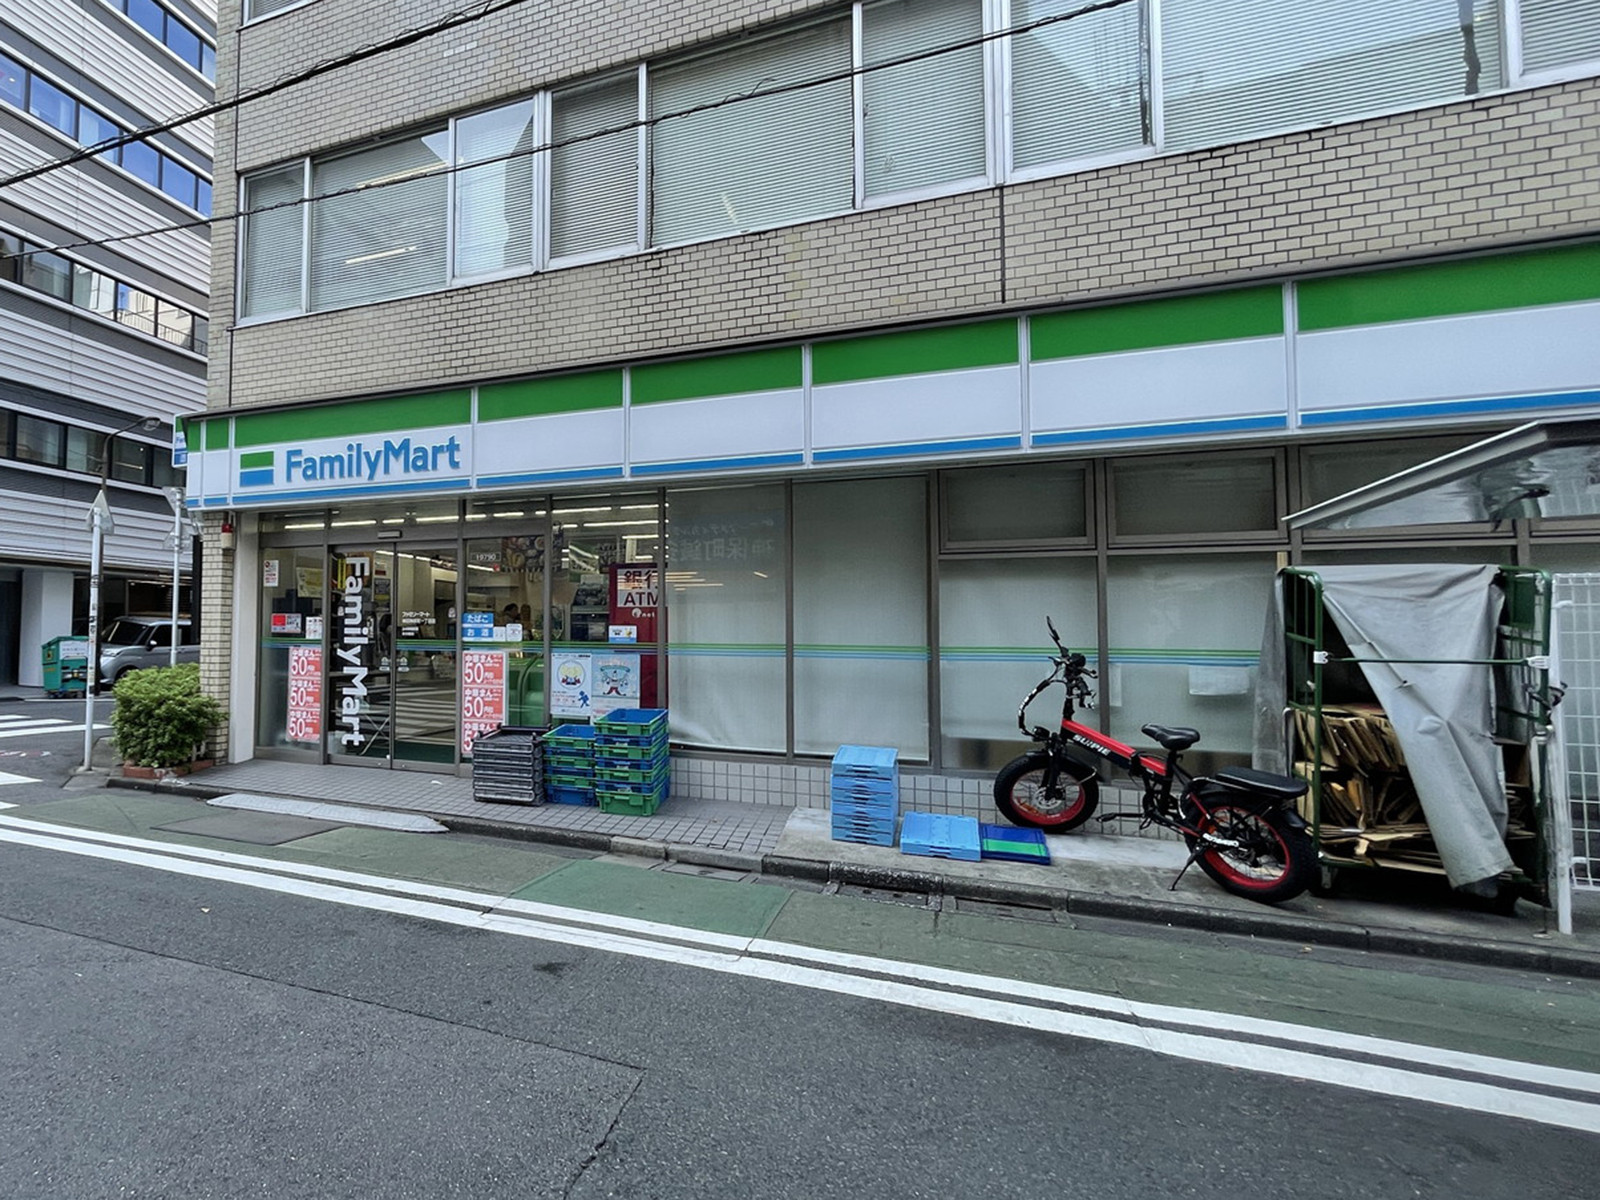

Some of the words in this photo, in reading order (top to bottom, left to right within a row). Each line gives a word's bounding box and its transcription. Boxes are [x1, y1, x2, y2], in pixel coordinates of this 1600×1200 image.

[286, 435, 460, 482] FamilyMart
[624, 592, 658, 606] ATM
[467, 614, 488, 624] たばこ
[336, 556, 370, 746] FamilyMart
